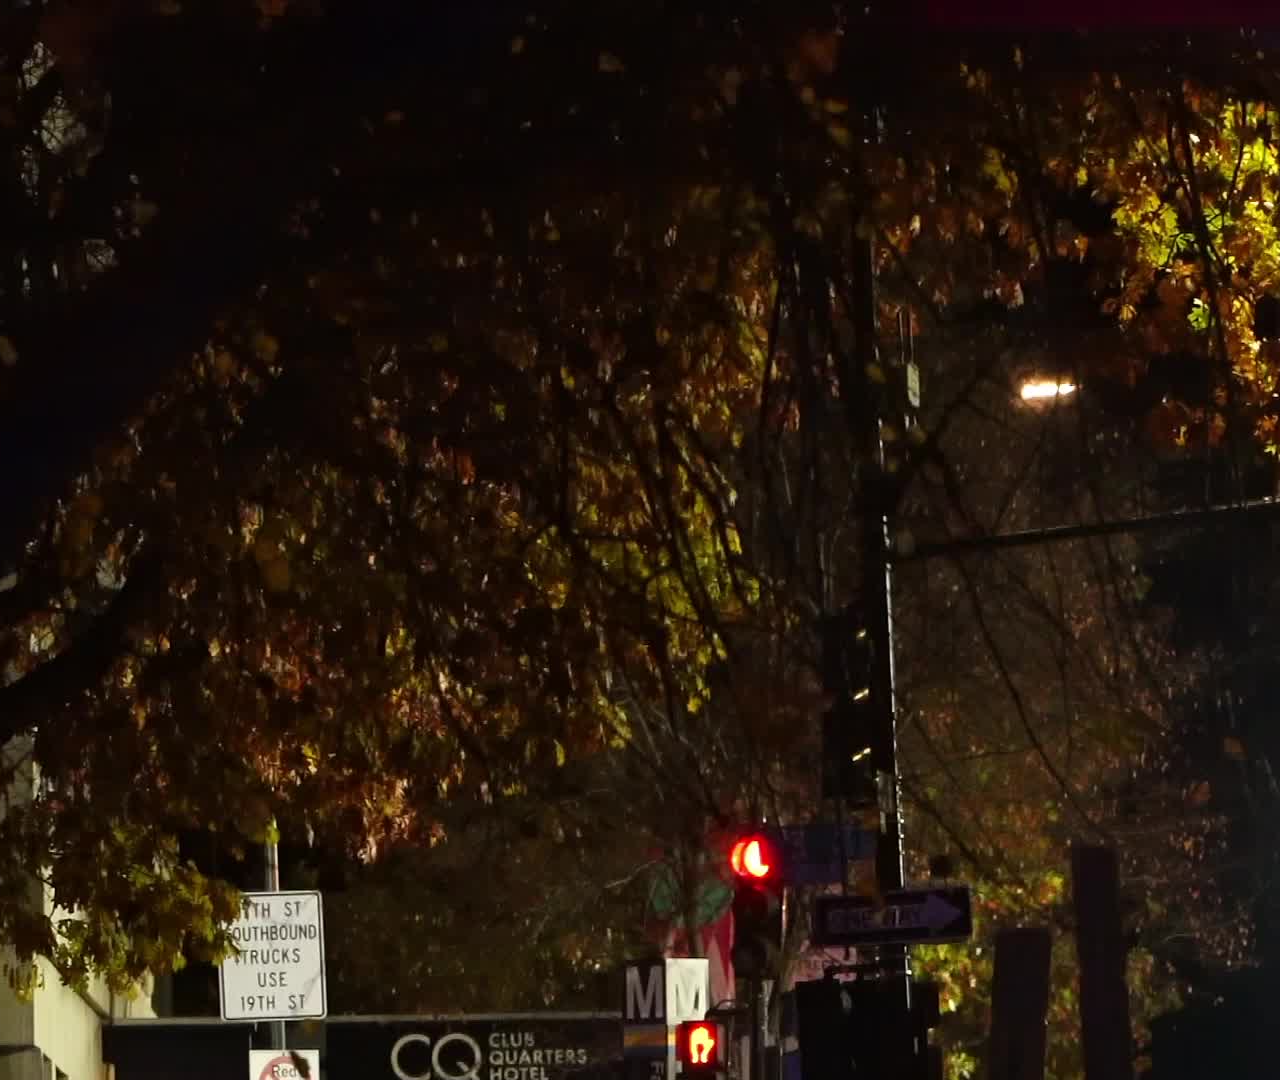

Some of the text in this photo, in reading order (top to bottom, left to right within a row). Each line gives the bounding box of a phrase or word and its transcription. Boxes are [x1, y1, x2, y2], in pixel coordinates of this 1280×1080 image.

[284, 901, 301, 917] ST
[228, 925, 317, 942] OUTHBOUND
[239, 948, 301, 965] TRUCKS
[257, 972, 288, 988] USE
[625, 965, 664, 1020] M
[241, 994, 305, 1012] 19TH ST
[488, 1032, 536, 1048] CLUB
[488, 1049, 588, 1066] QUARTERS
[272, 1064, 297, 1078] Red
